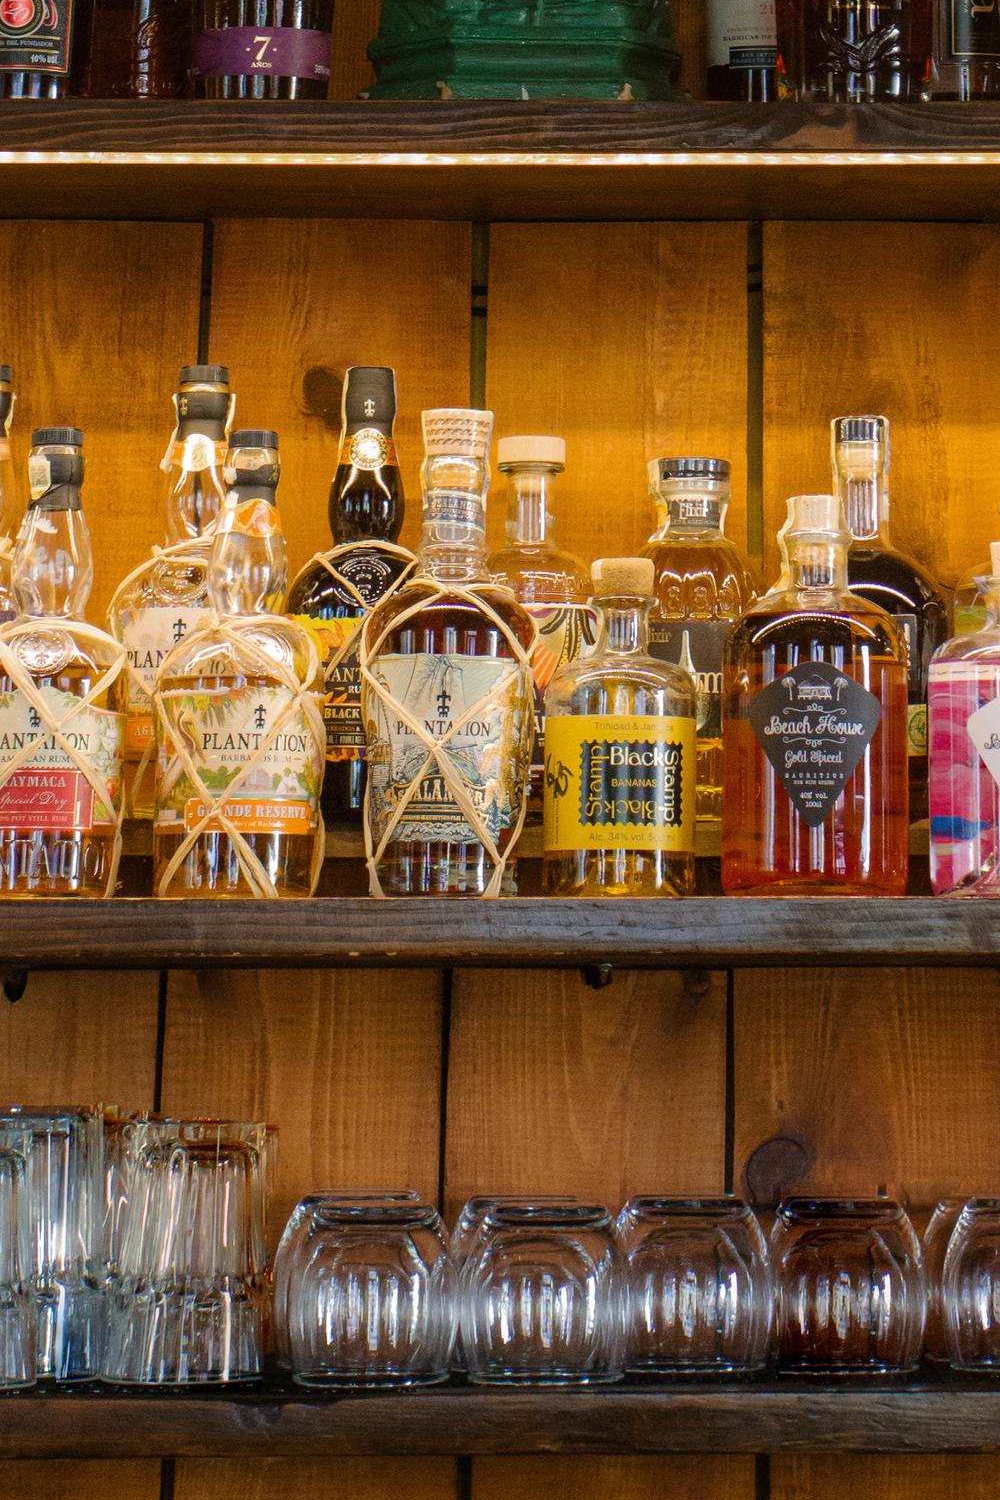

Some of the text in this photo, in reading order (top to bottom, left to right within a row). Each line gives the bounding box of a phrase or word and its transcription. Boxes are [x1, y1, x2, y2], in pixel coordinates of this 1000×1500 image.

[253, 35, 273, 62] 7
[324, 707, 361, 719] BLACK
[396, 719, 491, 737] PLNTAION
[640, 722, 674, 732] Jamca
[764, 713, 866, 736] Beach House
[202, 732, 308, 753] PLANTTION
[609, 745, 665, 767] Black
[784, 749, 845, 769] Gold Spiced
[584, 745, 610, 817] Stamp
[611, 778, 658, 788] BANANAS
[659, 749, 680, 822] Stamp
[255, 803, 306, 819] RÉSERVE
